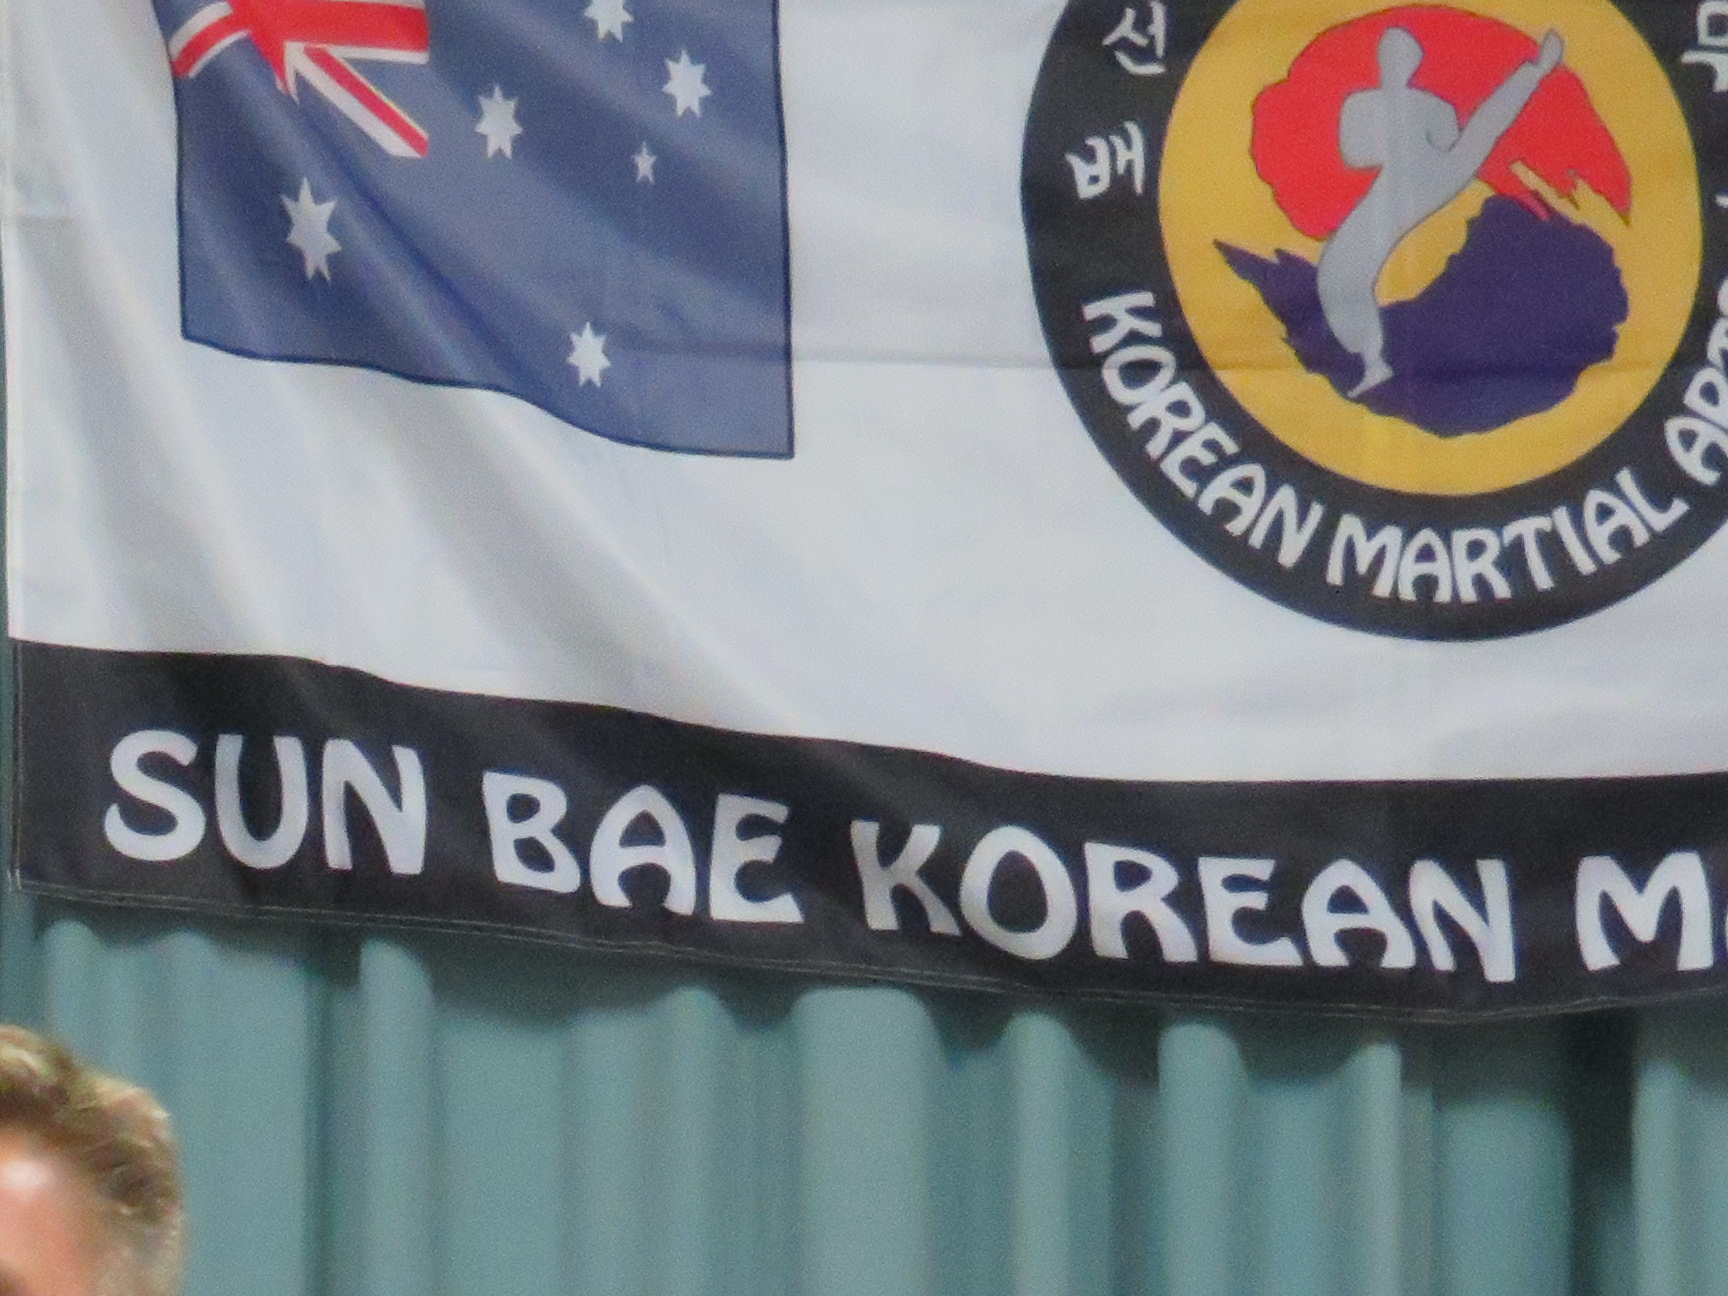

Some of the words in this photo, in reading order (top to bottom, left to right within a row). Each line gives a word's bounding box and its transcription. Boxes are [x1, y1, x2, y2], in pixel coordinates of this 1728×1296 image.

[1083, 291, 1324, 568] KOREAN
[1326, 466, 1690, 604] MARTIAL
[1664, 277, 1728, 487] ART
[102, 728, 429, 876] SUN
[481, 770, 805, 924] BAE
[848, 820, 1517, 984] KOREAN
[1575, 850, 1728, 972] M
